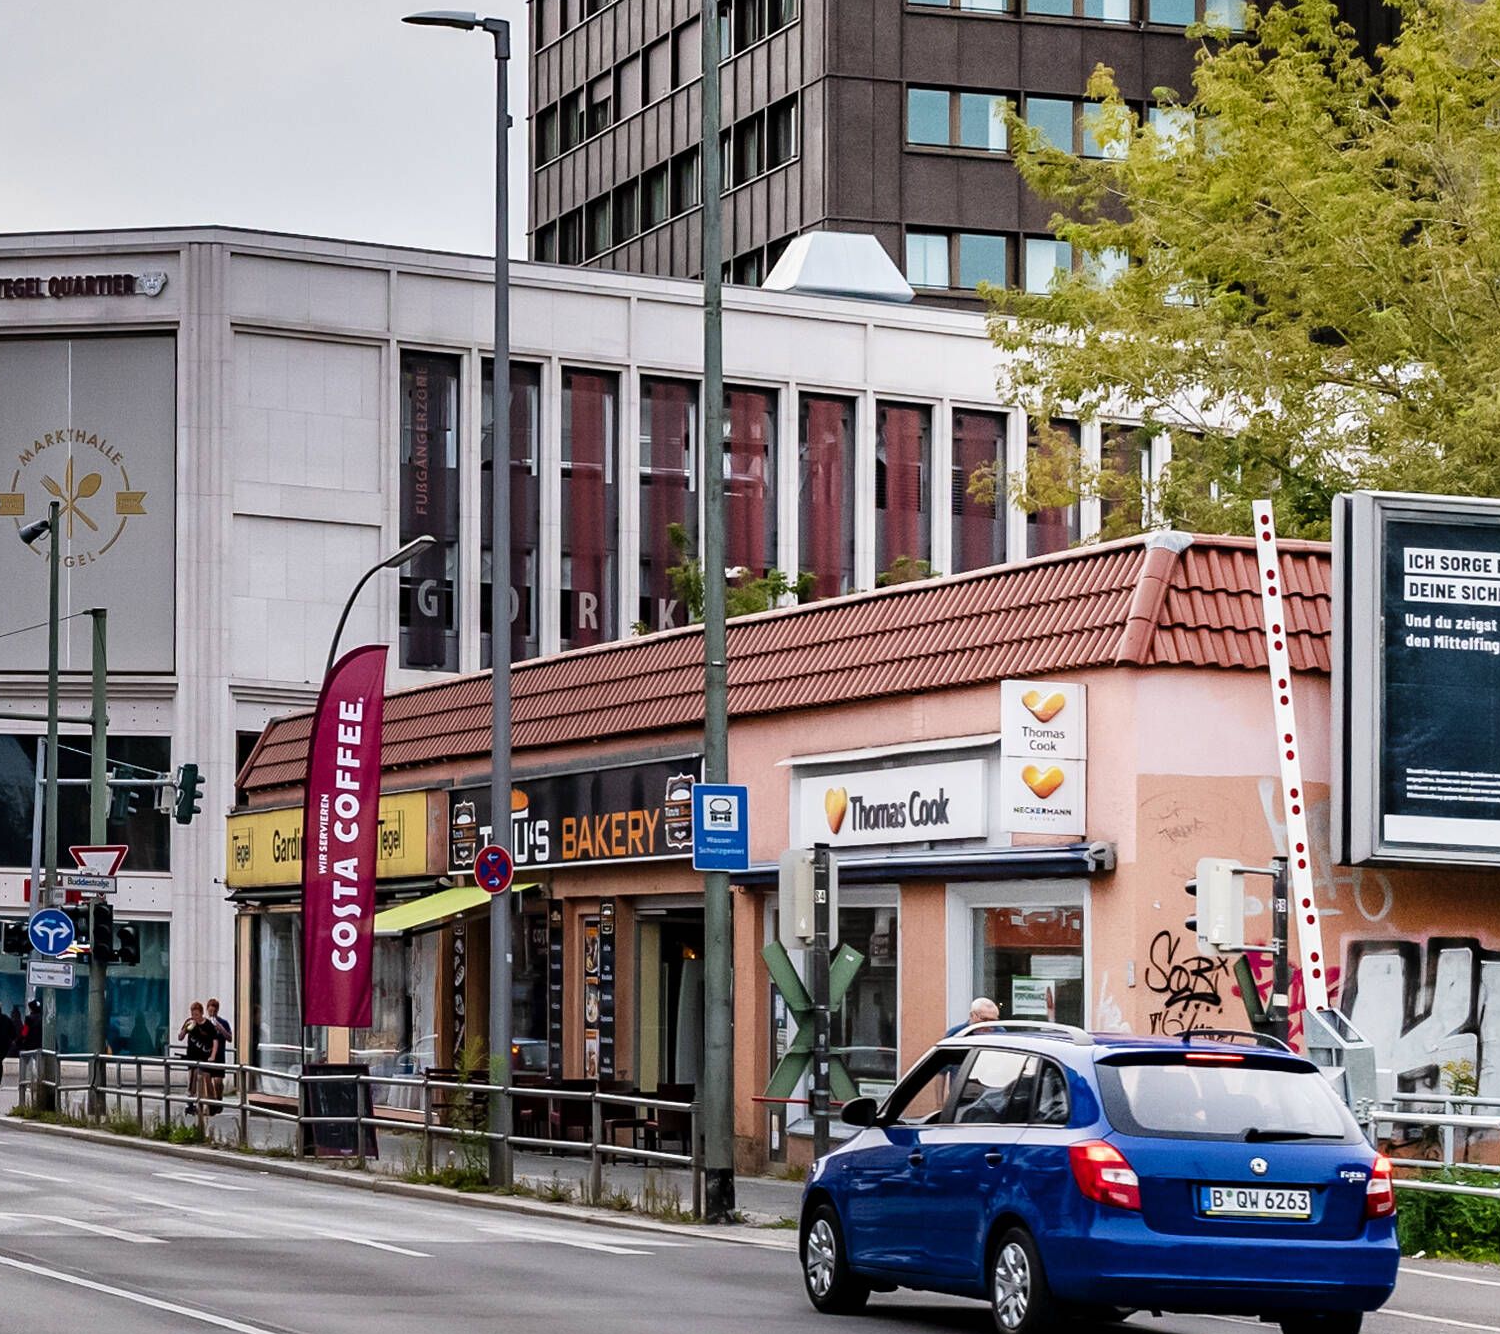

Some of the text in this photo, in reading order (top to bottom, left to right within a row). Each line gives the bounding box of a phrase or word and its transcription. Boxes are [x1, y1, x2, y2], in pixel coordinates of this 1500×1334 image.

[48, 274, 136, 299] QUARTIER
[18, 429, 123, 467] MARKTHALLE
[45, 551, 96, 568] TGEL
[1409, 554, 1435, 570] ICH
[1440, 556, 1492, 574] SORGE
[1409, 582, 1457, 600] DEINE
[1405, 613, 1431, 628] Und
[1435, 615, 1452, 629] du
[1455, 616, 1498, 634] zeigst
[1405, 633, 1431, 648] den
[1022, 726, 1066, 740] Thomas
[1029, 739, 1057, 751] Cook
[849, 788, 950, 832] Thomas Cook
[1013, 806, 1072, 816] NECKERMANN
[318, 793, 330, 875] WIR SERVIEREN
[378, 819, 401, 858] Tegel
[561, 808, 660, 860] BAKERY
[233, 835, 251, 869] Tegel
[331, 858, 362, 971] COSTA
[1213, 1190, 1308, 1210] B QW 6263
